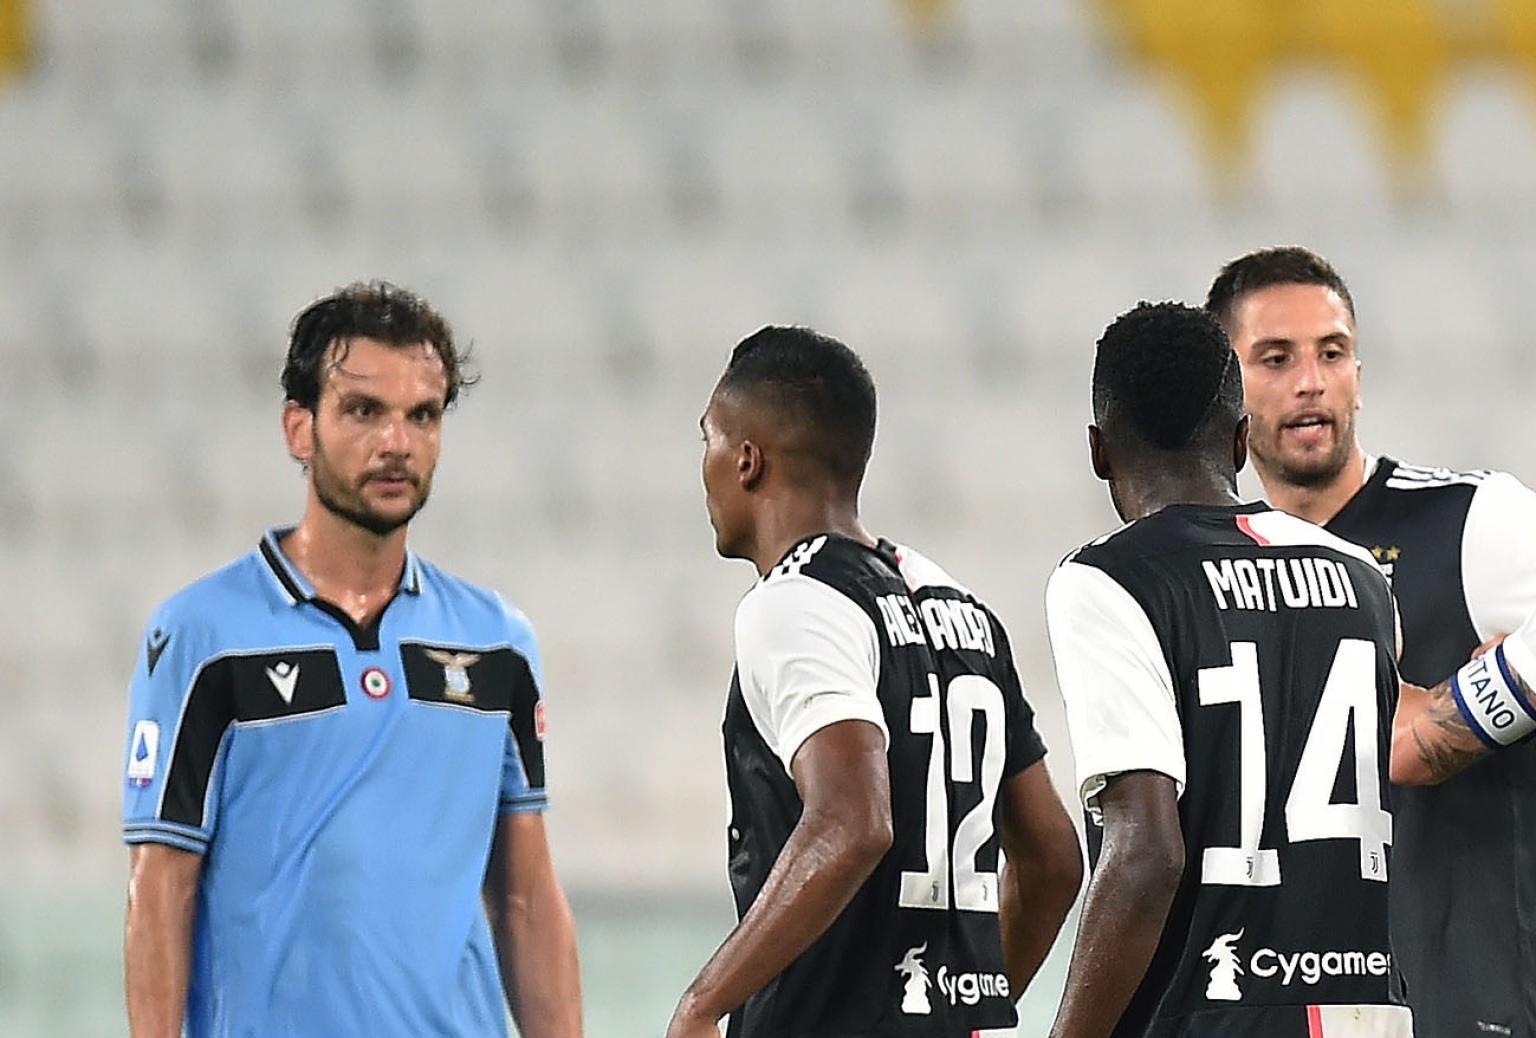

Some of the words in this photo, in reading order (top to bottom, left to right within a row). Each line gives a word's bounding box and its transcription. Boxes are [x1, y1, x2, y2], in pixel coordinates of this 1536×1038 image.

[1202, 558, 1358, 612] MATUIDI
[898, 672, 1006, 913] 12
[1198, 638, 1392, 887] 14
[1250, 948, 1391, 986] Cygame
